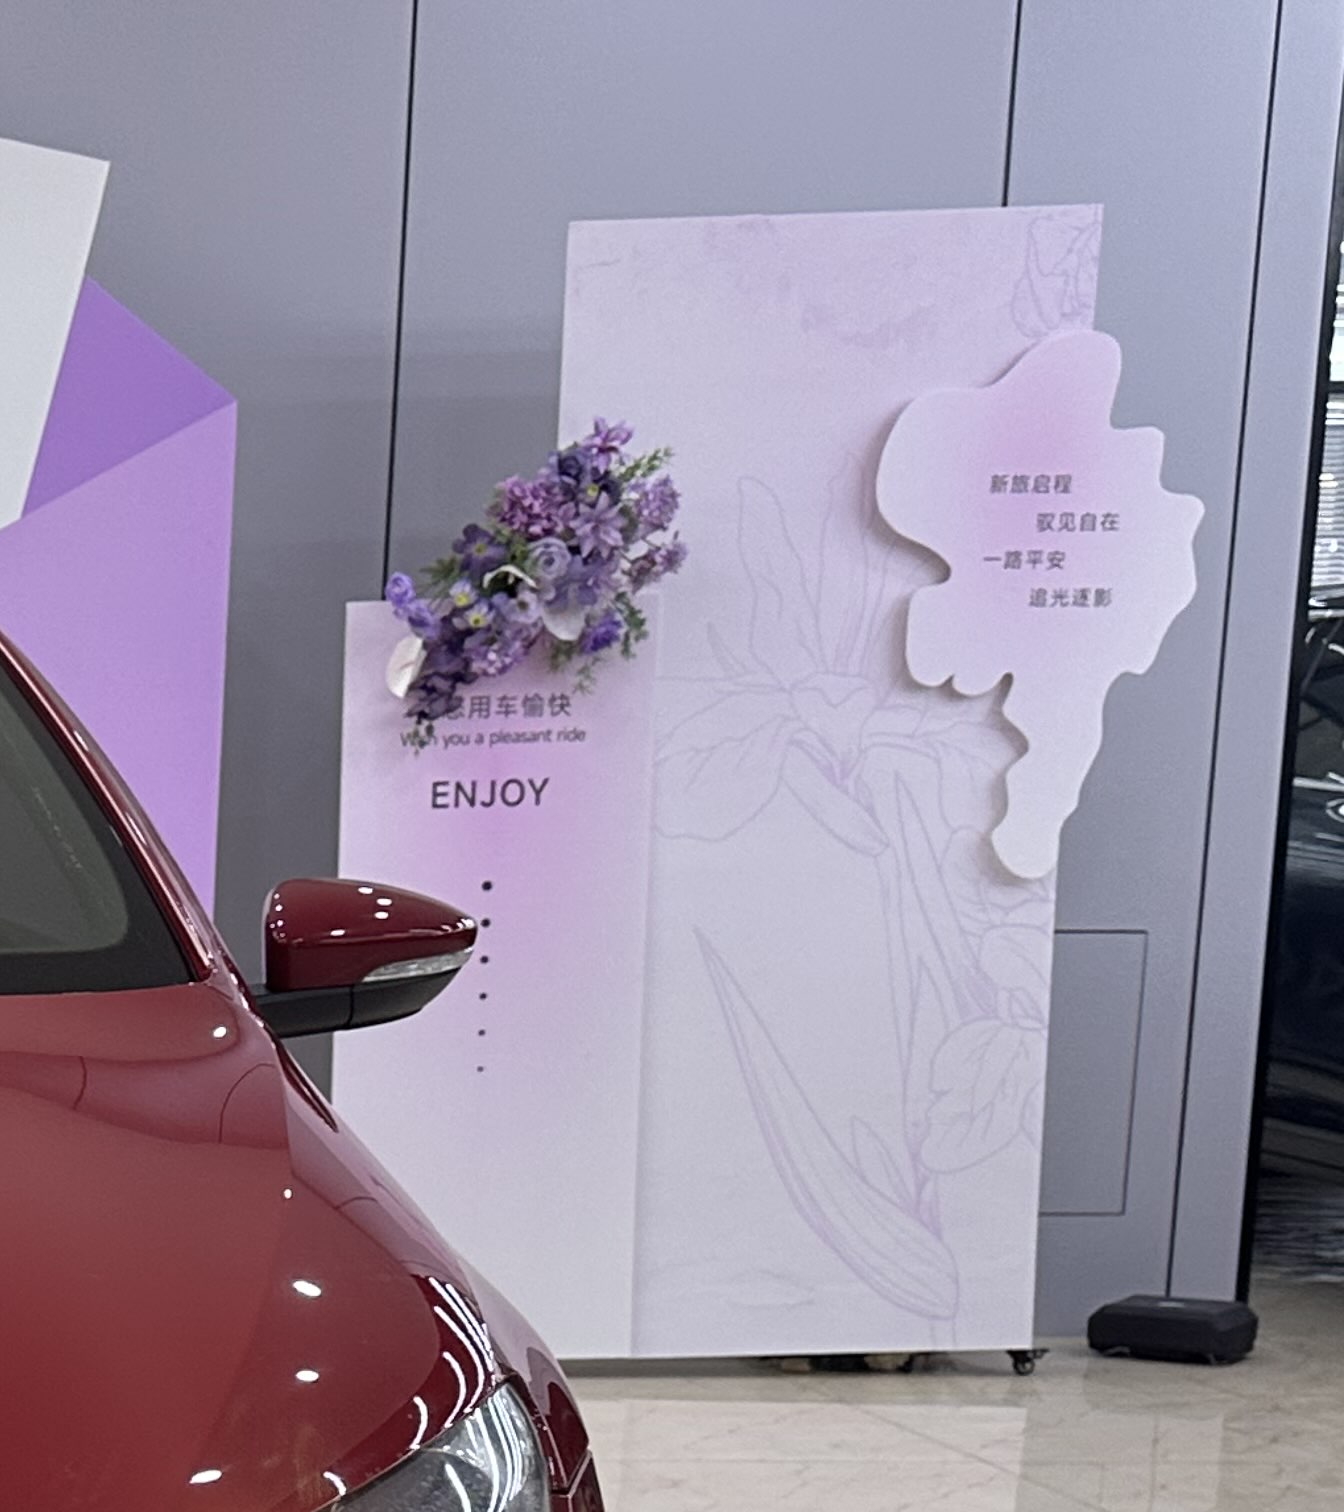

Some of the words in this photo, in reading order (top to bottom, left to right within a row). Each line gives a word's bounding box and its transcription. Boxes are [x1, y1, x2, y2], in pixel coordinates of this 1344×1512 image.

[982, 549, 1066, 571] 一路平安
[442, 734, 471, 750] you
[474, 733, 485, 746] a
[489, 728, 553, 749] pleasant
[556, 727, 587, 743] ride
[431, 777, 551, 809] ENJOY
